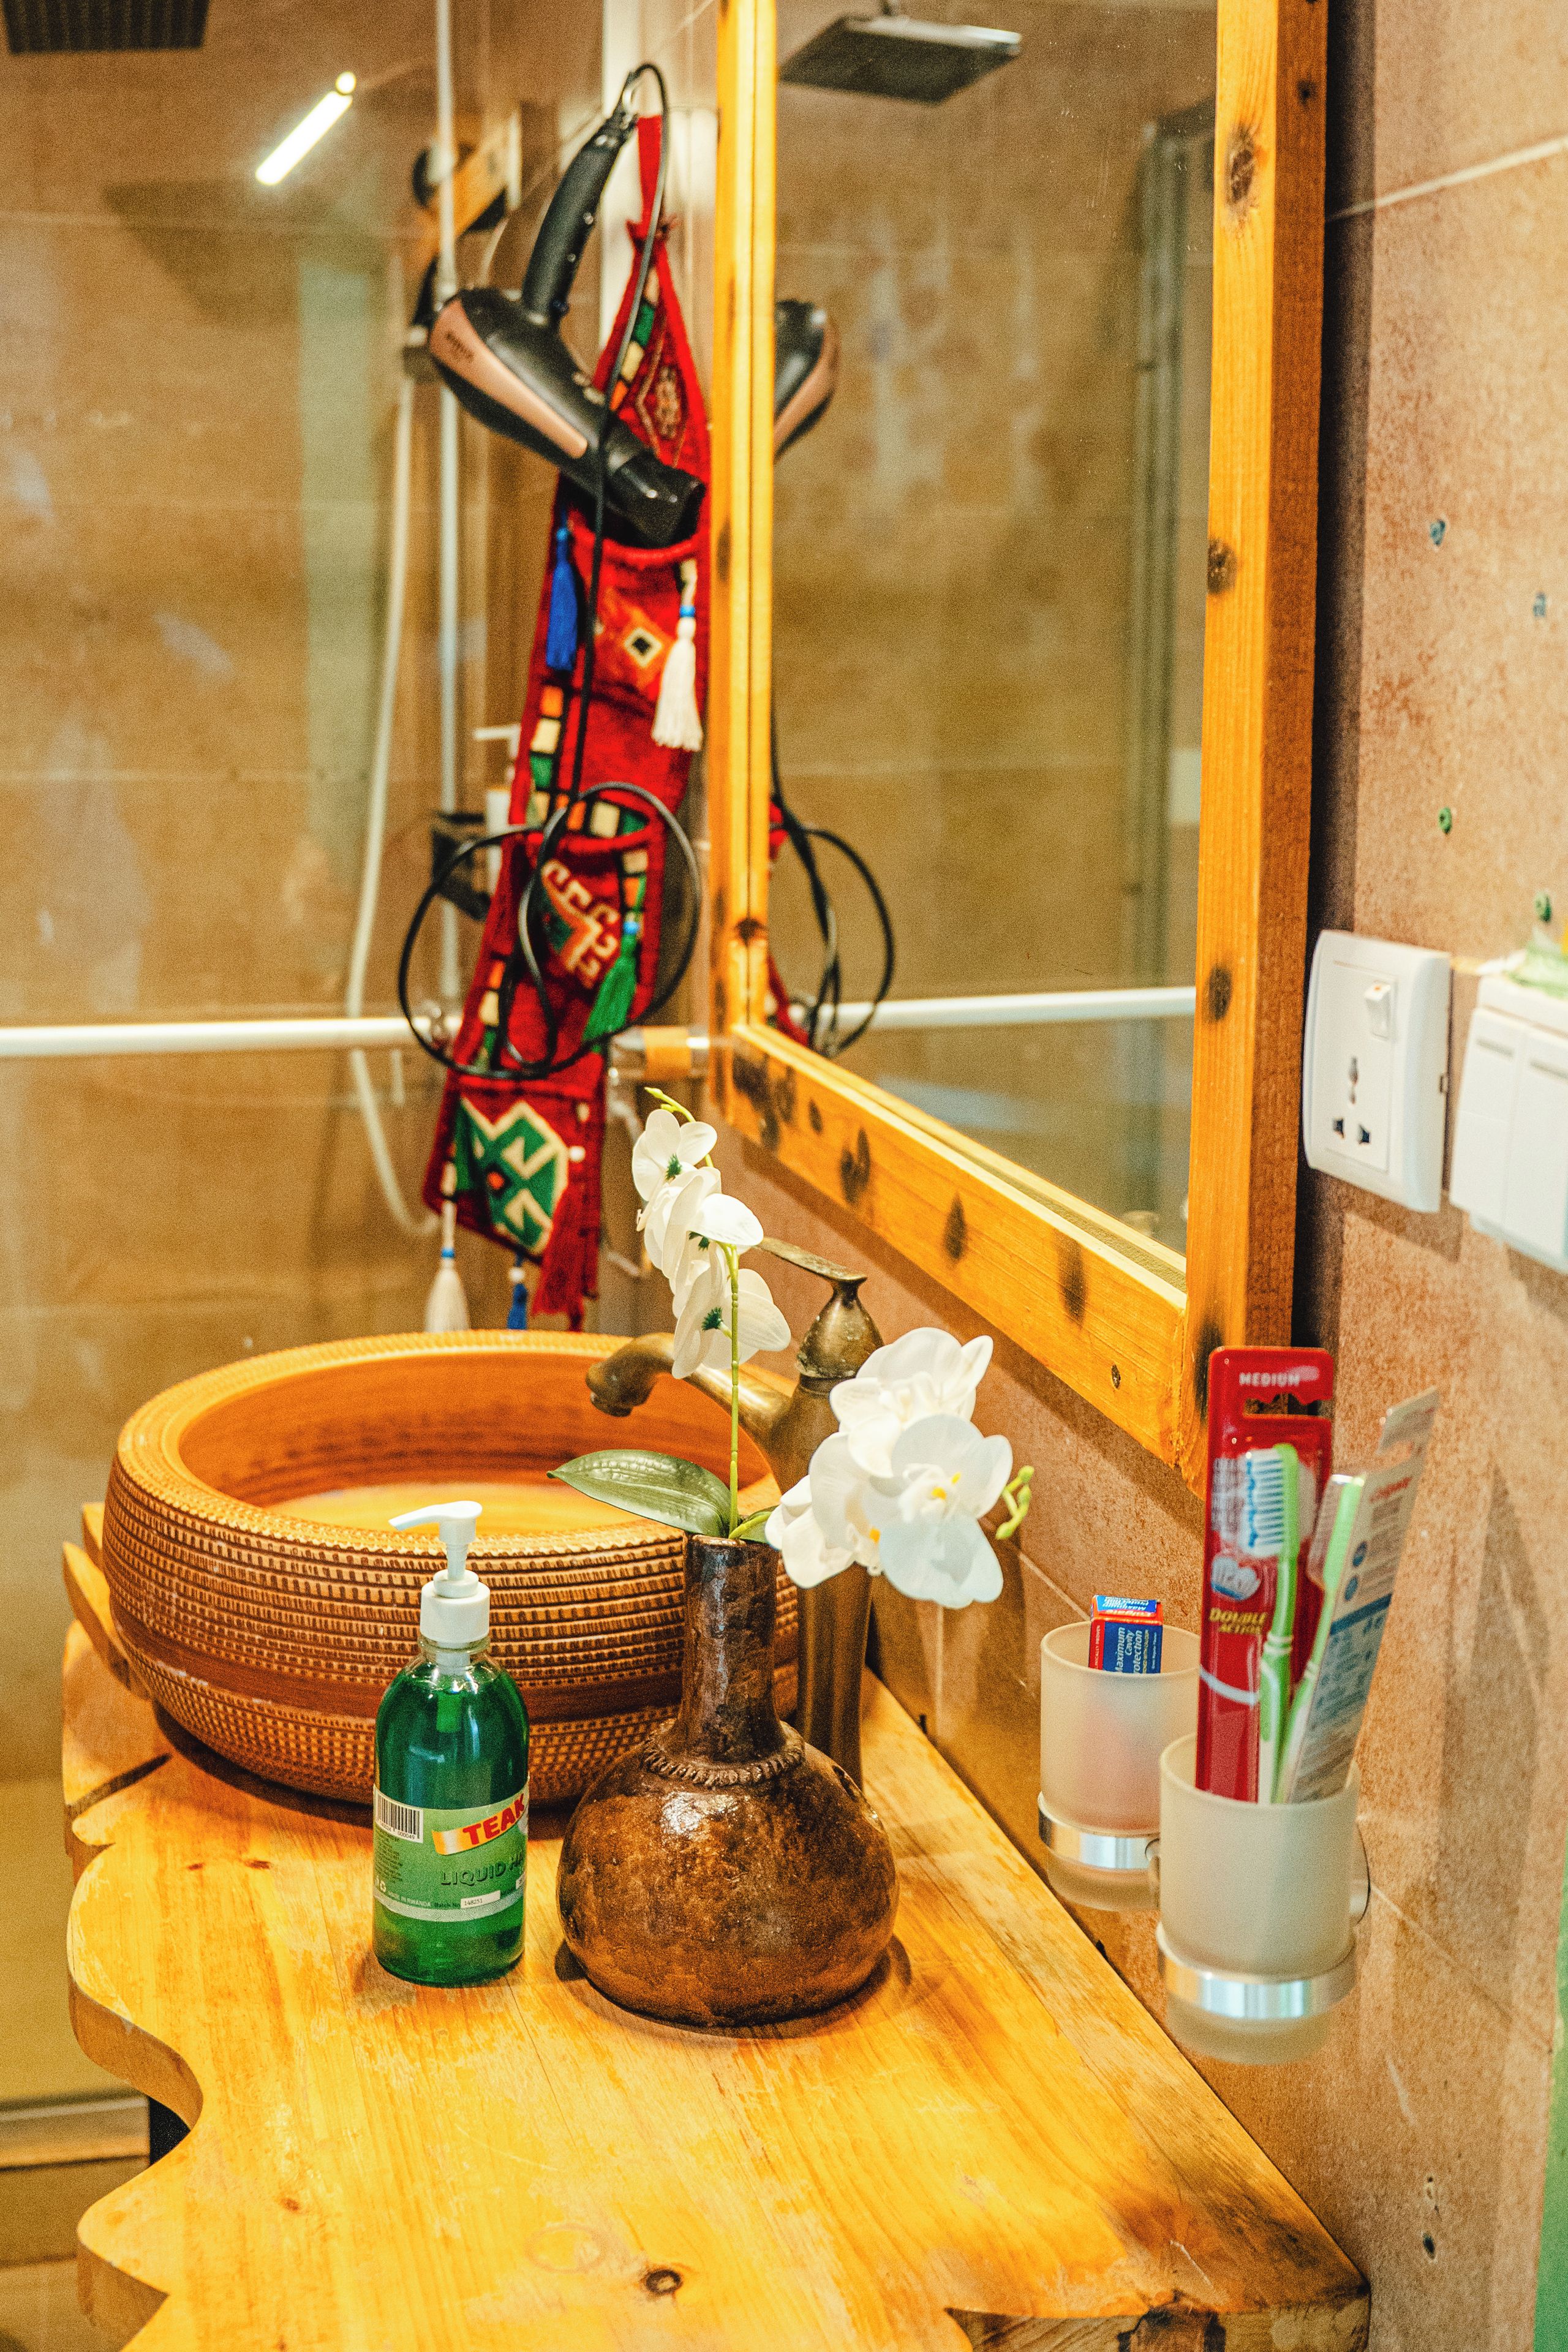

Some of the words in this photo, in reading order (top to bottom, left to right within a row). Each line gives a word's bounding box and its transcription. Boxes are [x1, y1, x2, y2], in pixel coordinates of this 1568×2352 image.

[1239, 1372, 1300, 1387] MEDIUM
[1125, 1629, 1135, 1656] Cavity
[1133, 1630, 1142, 1673] rotection
[462, 1793, 525, 1845] TEAK
[441, 1862, 506, 1886] LIQUID
